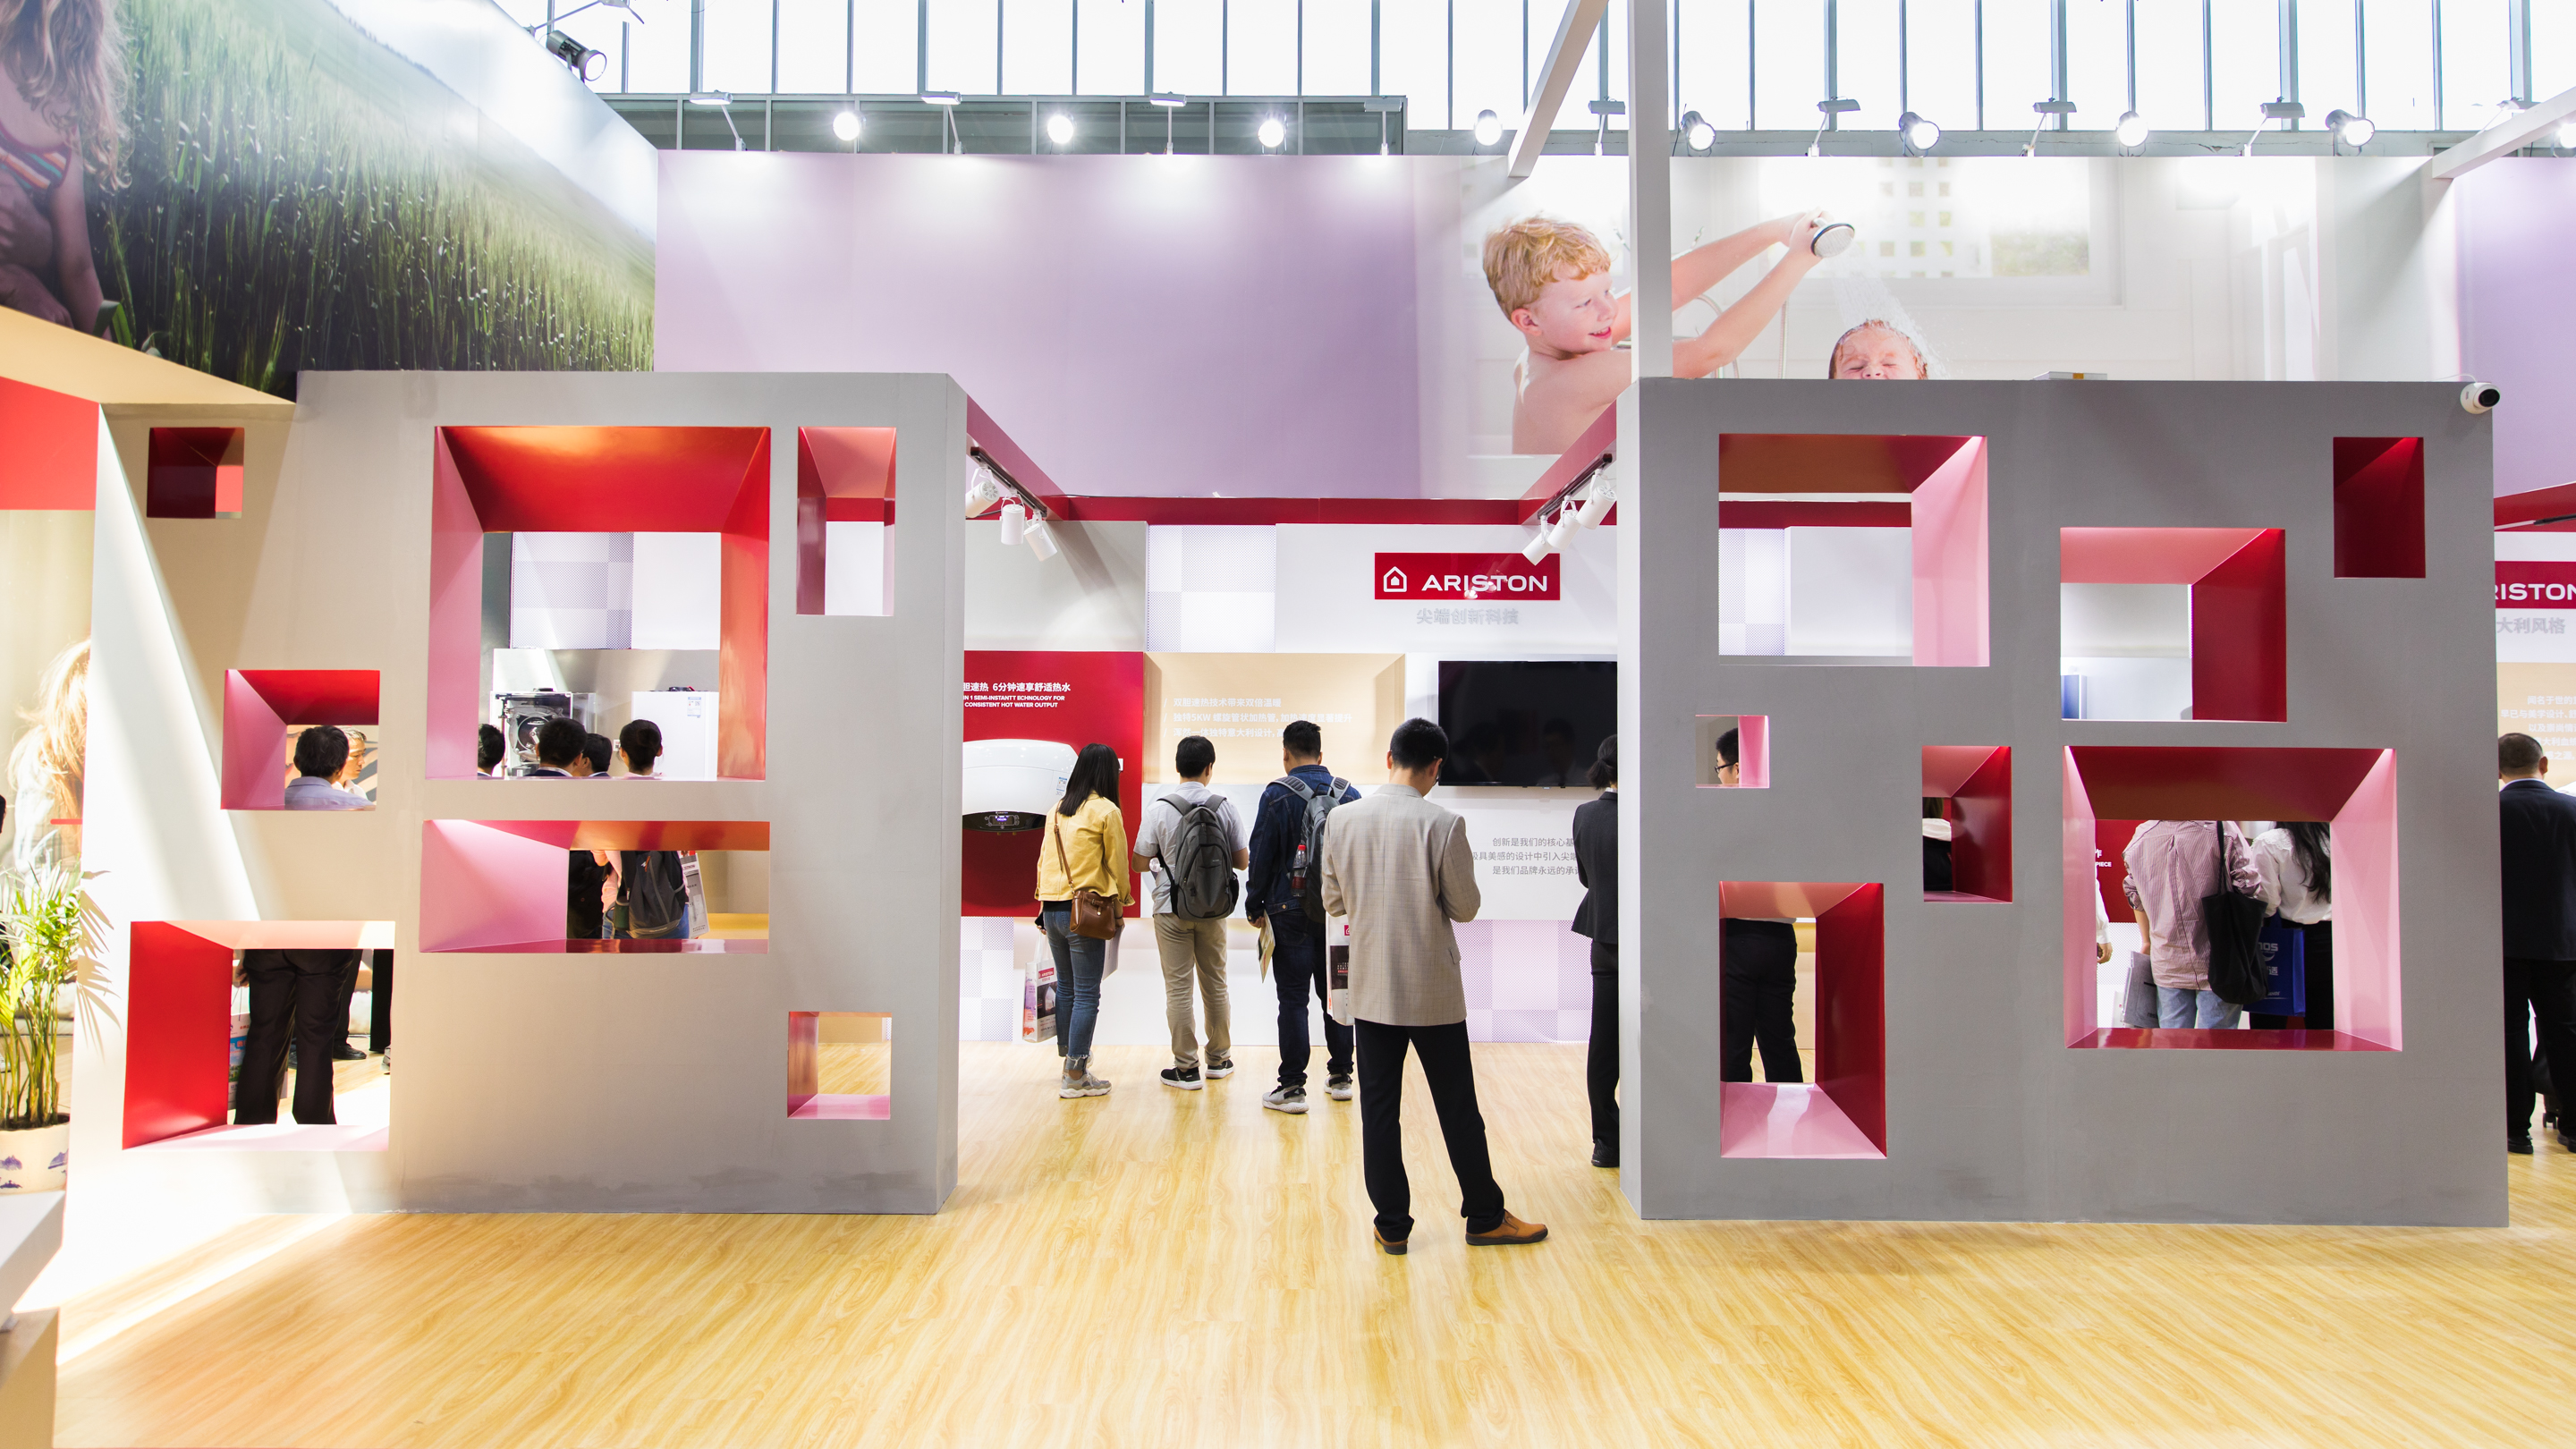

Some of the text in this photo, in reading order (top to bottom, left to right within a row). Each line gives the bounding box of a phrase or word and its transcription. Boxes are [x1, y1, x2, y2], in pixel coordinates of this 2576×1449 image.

[1421, 574, 1547, 592] ARISTON
[2496, 582, 2576, 601] ISTON
[1417, 607, 1519, 625] 尖端创新科技
[992, 682, 1072, 692] 6分钟速享舒适热水
[1174, 698, 1282, 708] 双胆速热技术带来双倍温暖
